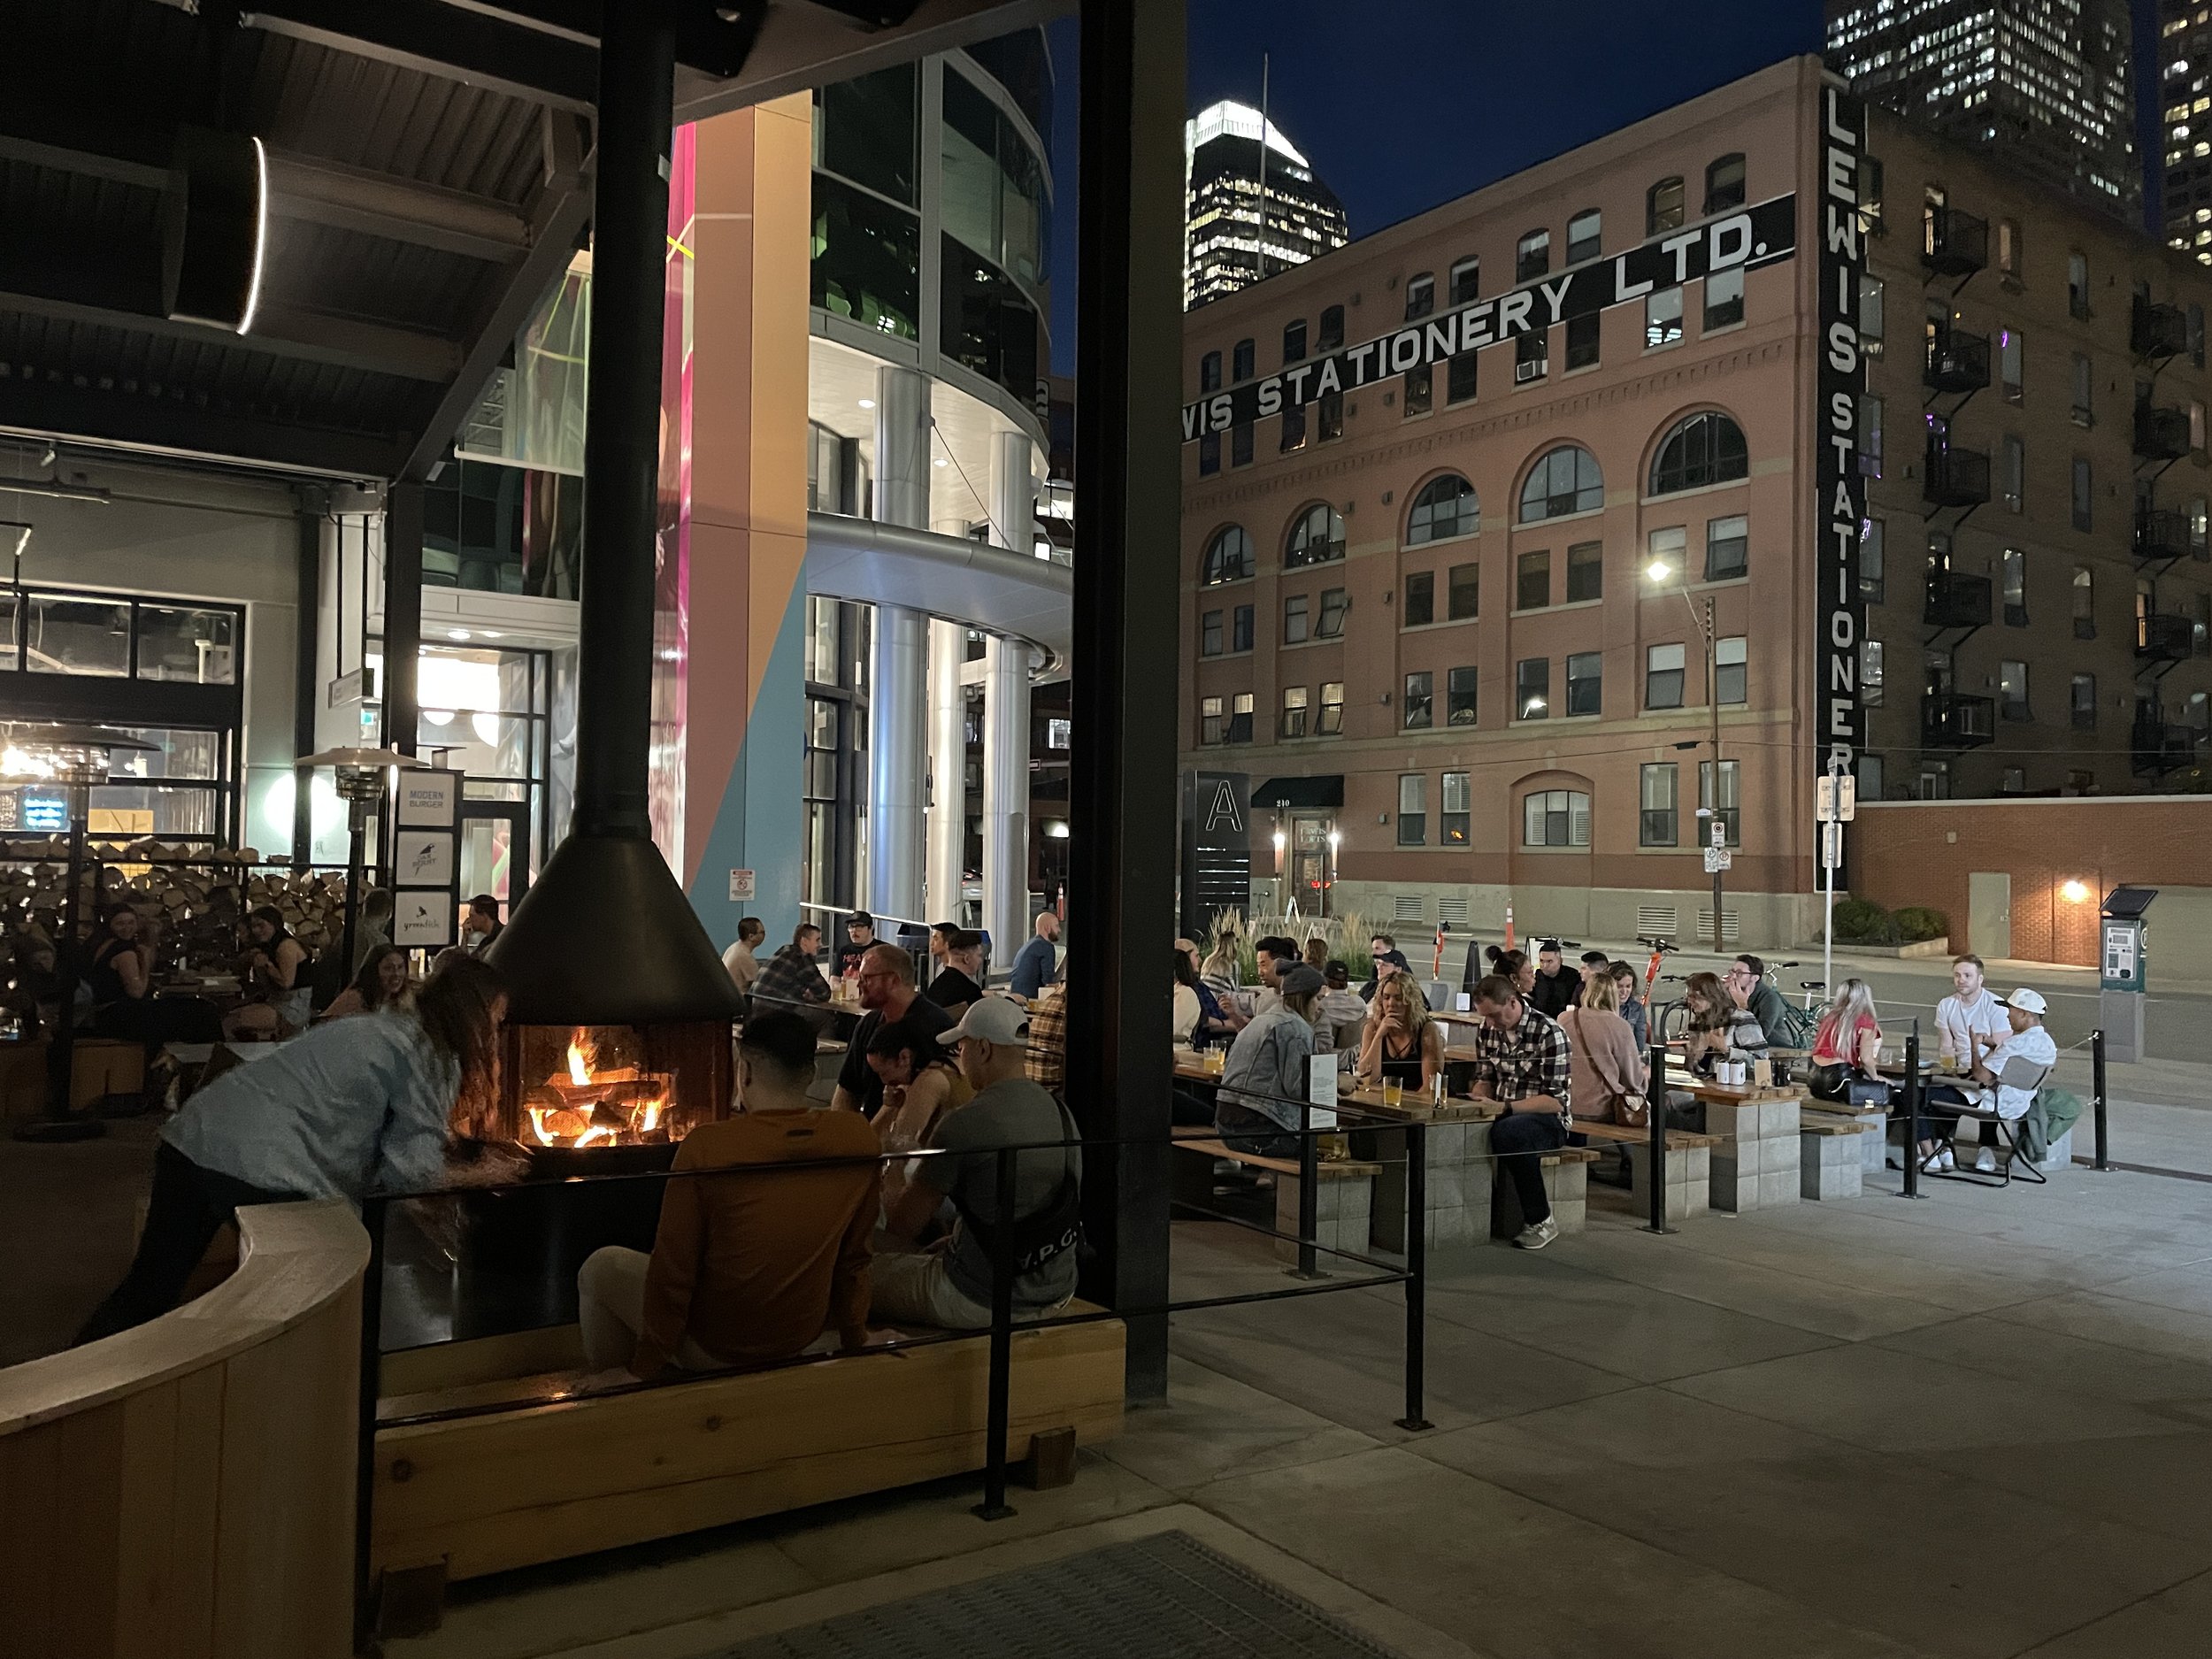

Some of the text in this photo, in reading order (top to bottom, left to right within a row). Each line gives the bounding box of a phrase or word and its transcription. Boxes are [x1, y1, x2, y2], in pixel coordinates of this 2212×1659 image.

[1258, 274, 1573, 416] STATIONERY
[1615, 213, 1768, 302] LTD.
[1828, 88, 1856, 776] LEWIS STATIONER
[410, 790, 444, 800] MODERN
[1205, 780, 1243, 832] A
